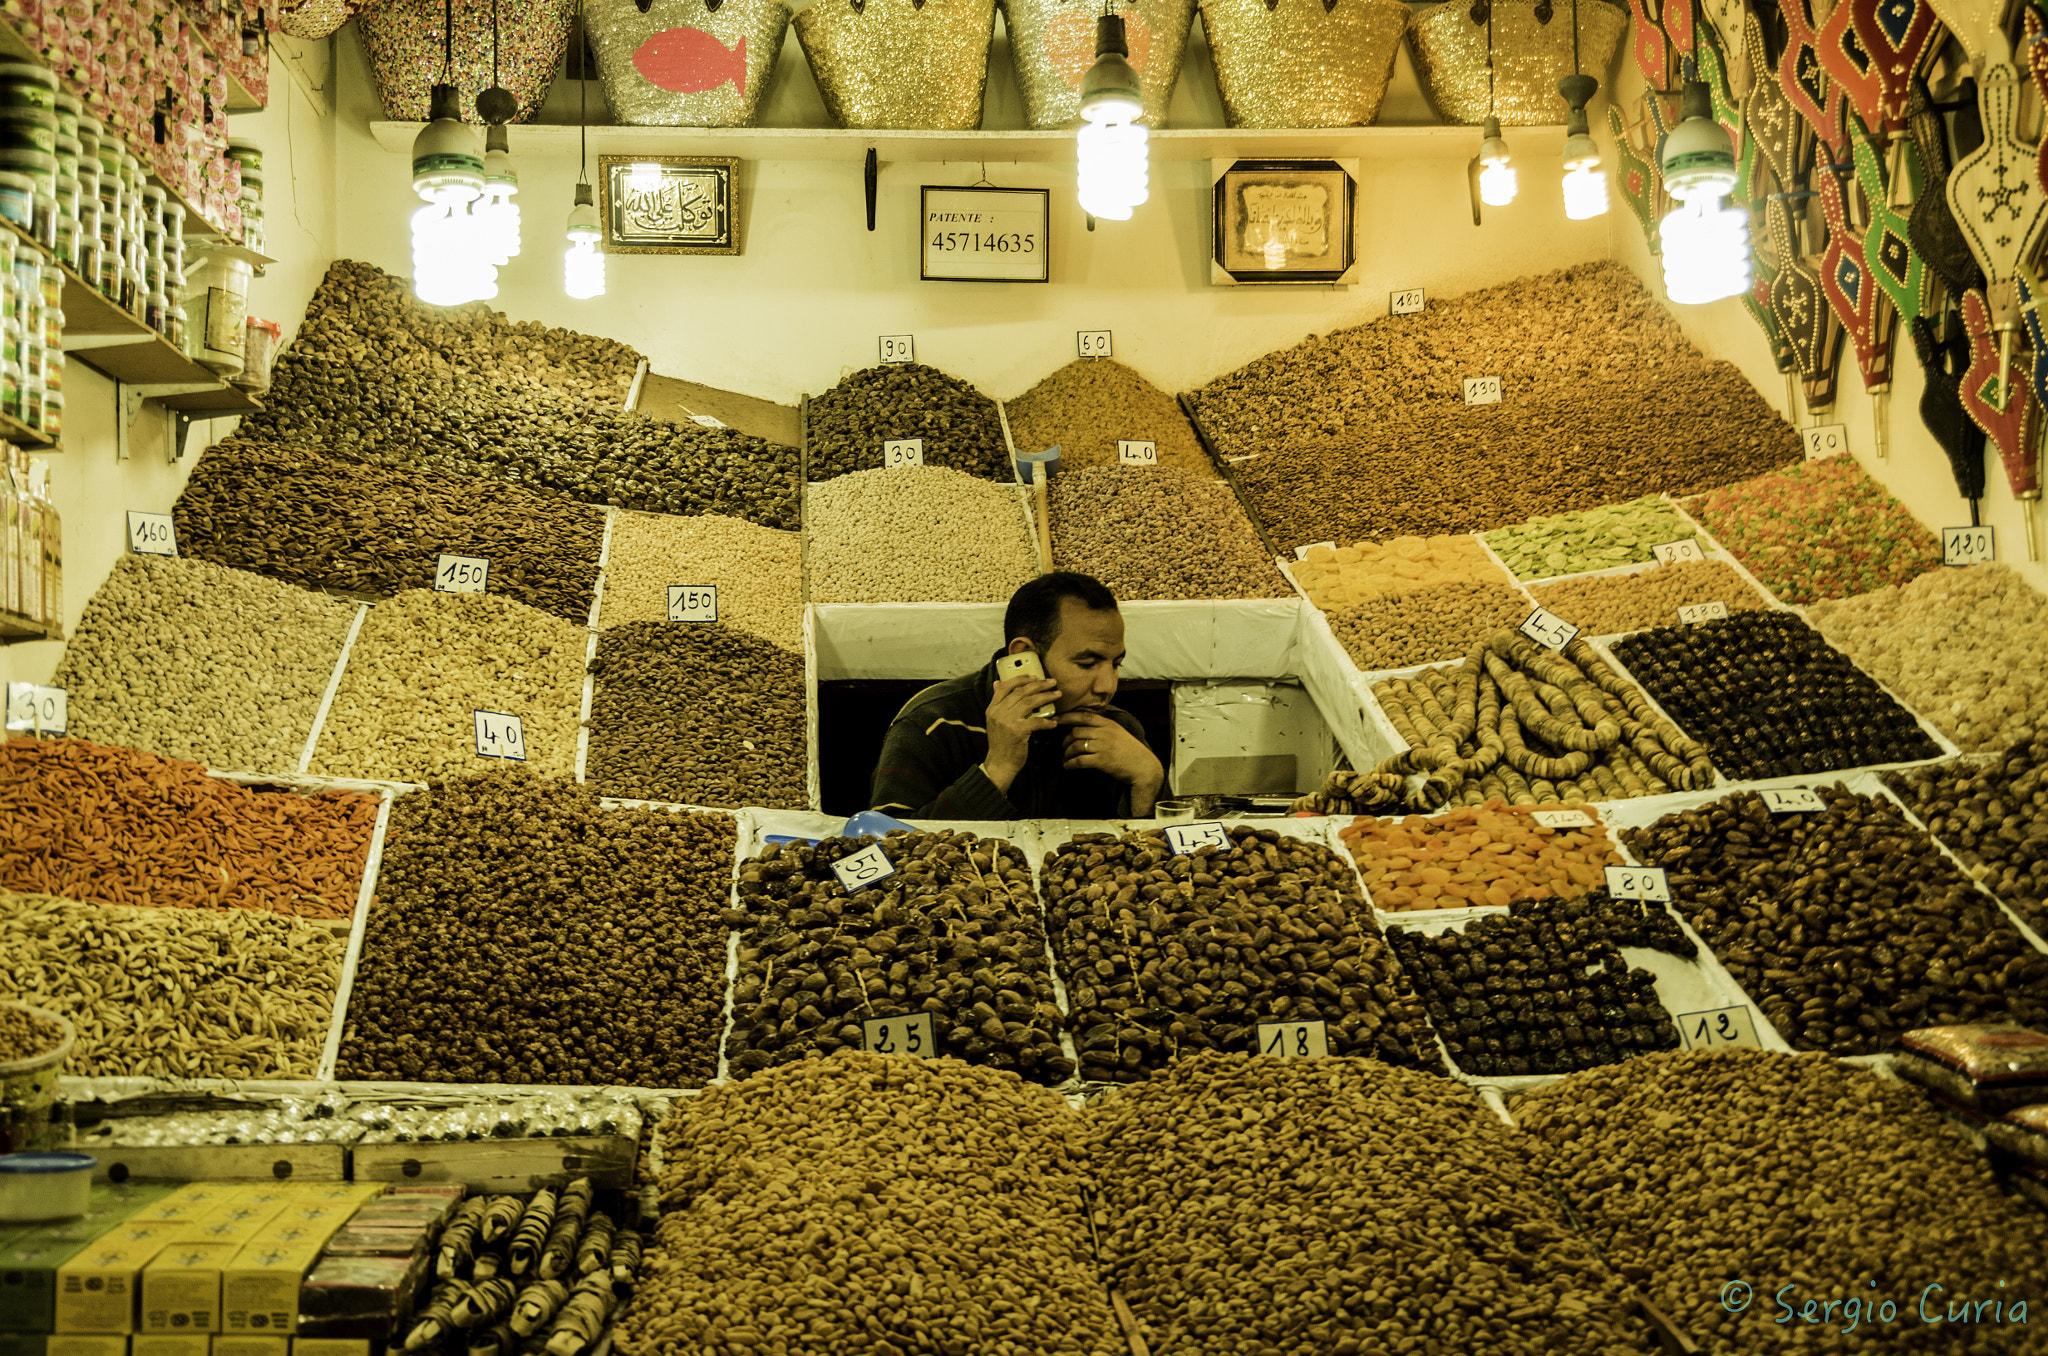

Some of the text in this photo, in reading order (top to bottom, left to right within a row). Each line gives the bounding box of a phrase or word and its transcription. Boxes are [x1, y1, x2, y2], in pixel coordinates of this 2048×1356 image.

[929, 212, 982, 223] PATENTE
[932, 232, 1034, 253] 45714635
[1396, 291, 1420, 307] 180
[886, 340, 906, 357] 90
[1083, 335, 1105, 350] 60
[1468, 382, 1497, 398] 130
[1125, 444, 1153, 460] 40
[1811, 433, 1837, 452] 80
[892, 445, 916, 463] 30
[136, 521, 168, 542] 160
[442, 562, 483, 584] 150
[672, 591, 711, 612] 150
[1531, 614, 1574, 645] 45
[18, 691, 55, 721] 30
[484, 719, 517, 744] 40
[1177, 829, 1223, 848] 45
[845, 853, 879, 880] 50
[1621, 872, 1654, 891] 80
[873, 1022, 921, 1054] 25
[1695, 1013, 1738, 1045] 12
[1266, 1027, 1309, 1058] 18
